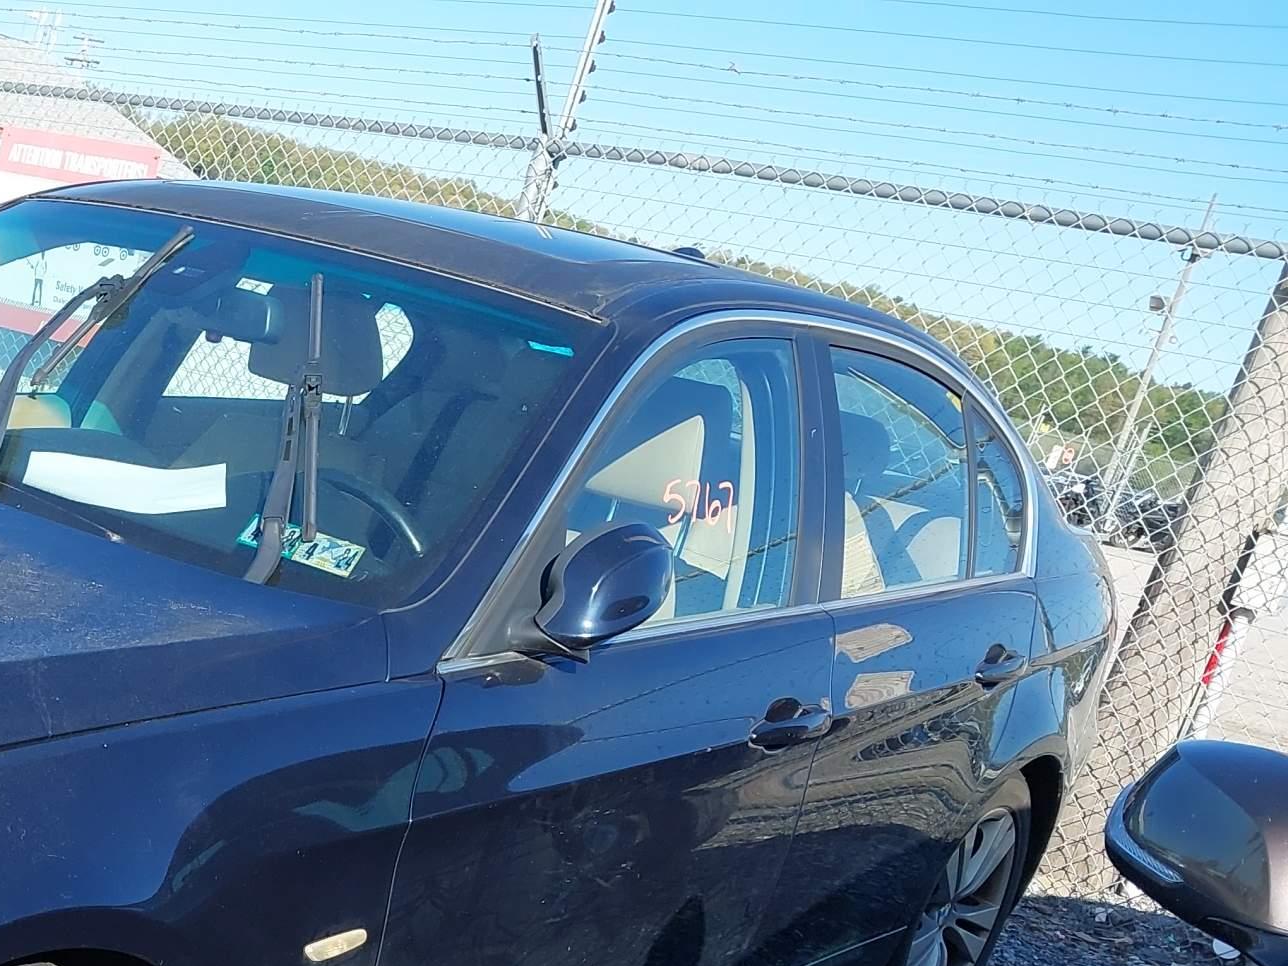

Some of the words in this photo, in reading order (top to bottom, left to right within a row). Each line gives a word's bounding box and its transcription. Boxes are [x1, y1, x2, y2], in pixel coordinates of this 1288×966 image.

[8, 143, 62, 169] ATTENTION
[663, 478, 734, 534] 5767
[303, 542, 320, 561] 4
[334, 547, 359, 571] 24
